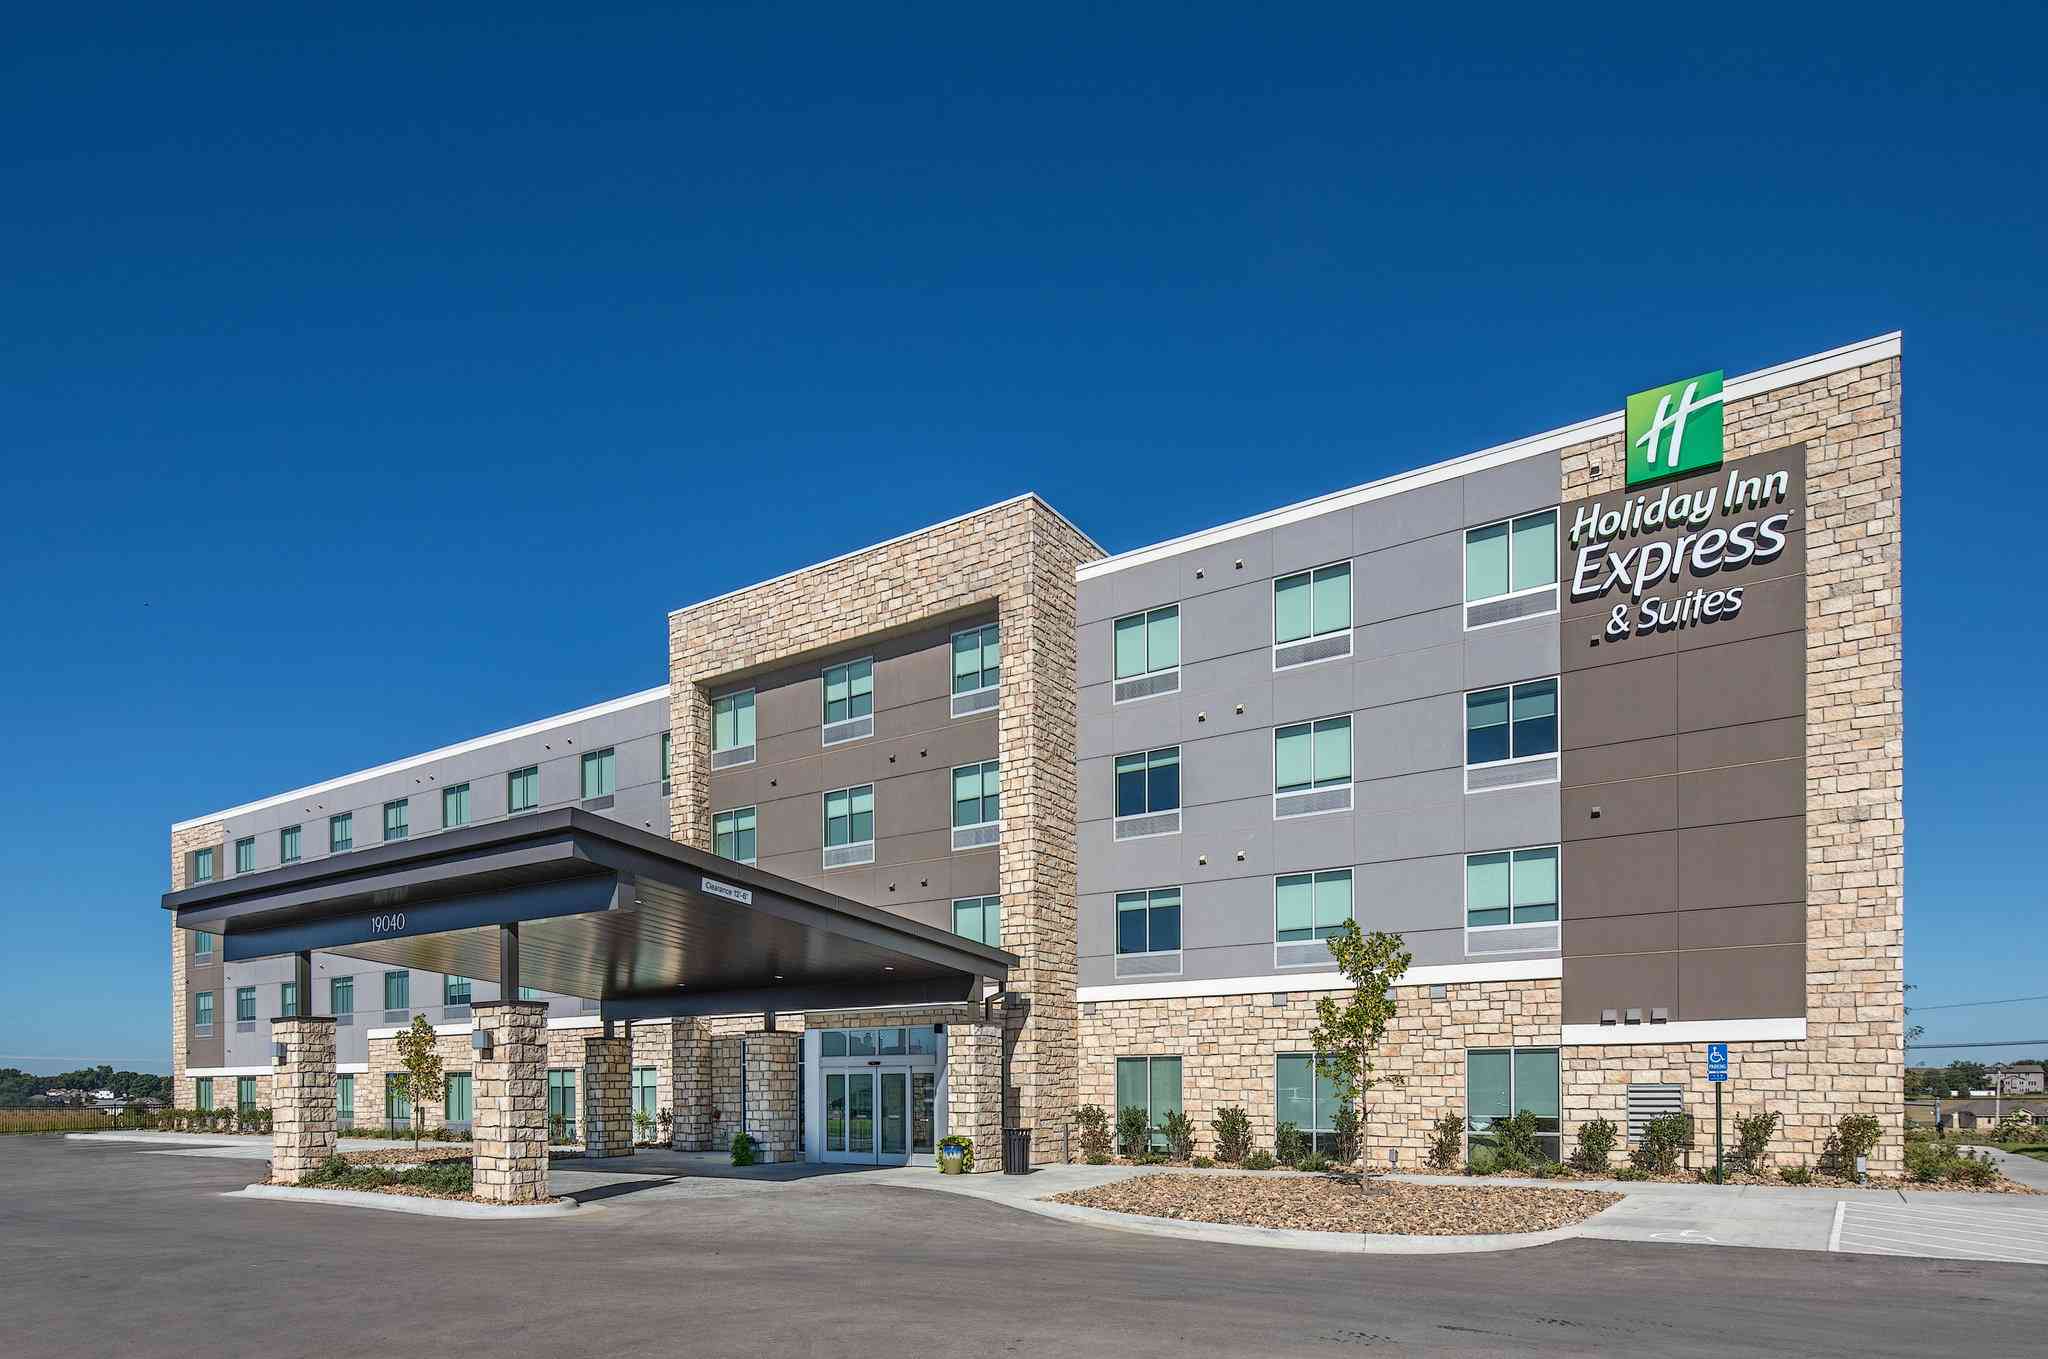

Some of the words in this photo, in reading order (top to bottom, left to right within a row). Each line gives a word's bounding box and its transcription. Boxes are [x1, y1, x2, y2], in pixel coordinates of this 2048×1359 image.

[1569, 487, 1718, 543] Holiday
[1724, 469, 1789, 508] Inn
[1571, 513, 1789, 597] Express
[1606, 603, 1630, 635] &
[1638, 587, 1744, 629] Suites
[705, 881, 733, 895] Clearance
[372, 912, 405, 933] 19040
